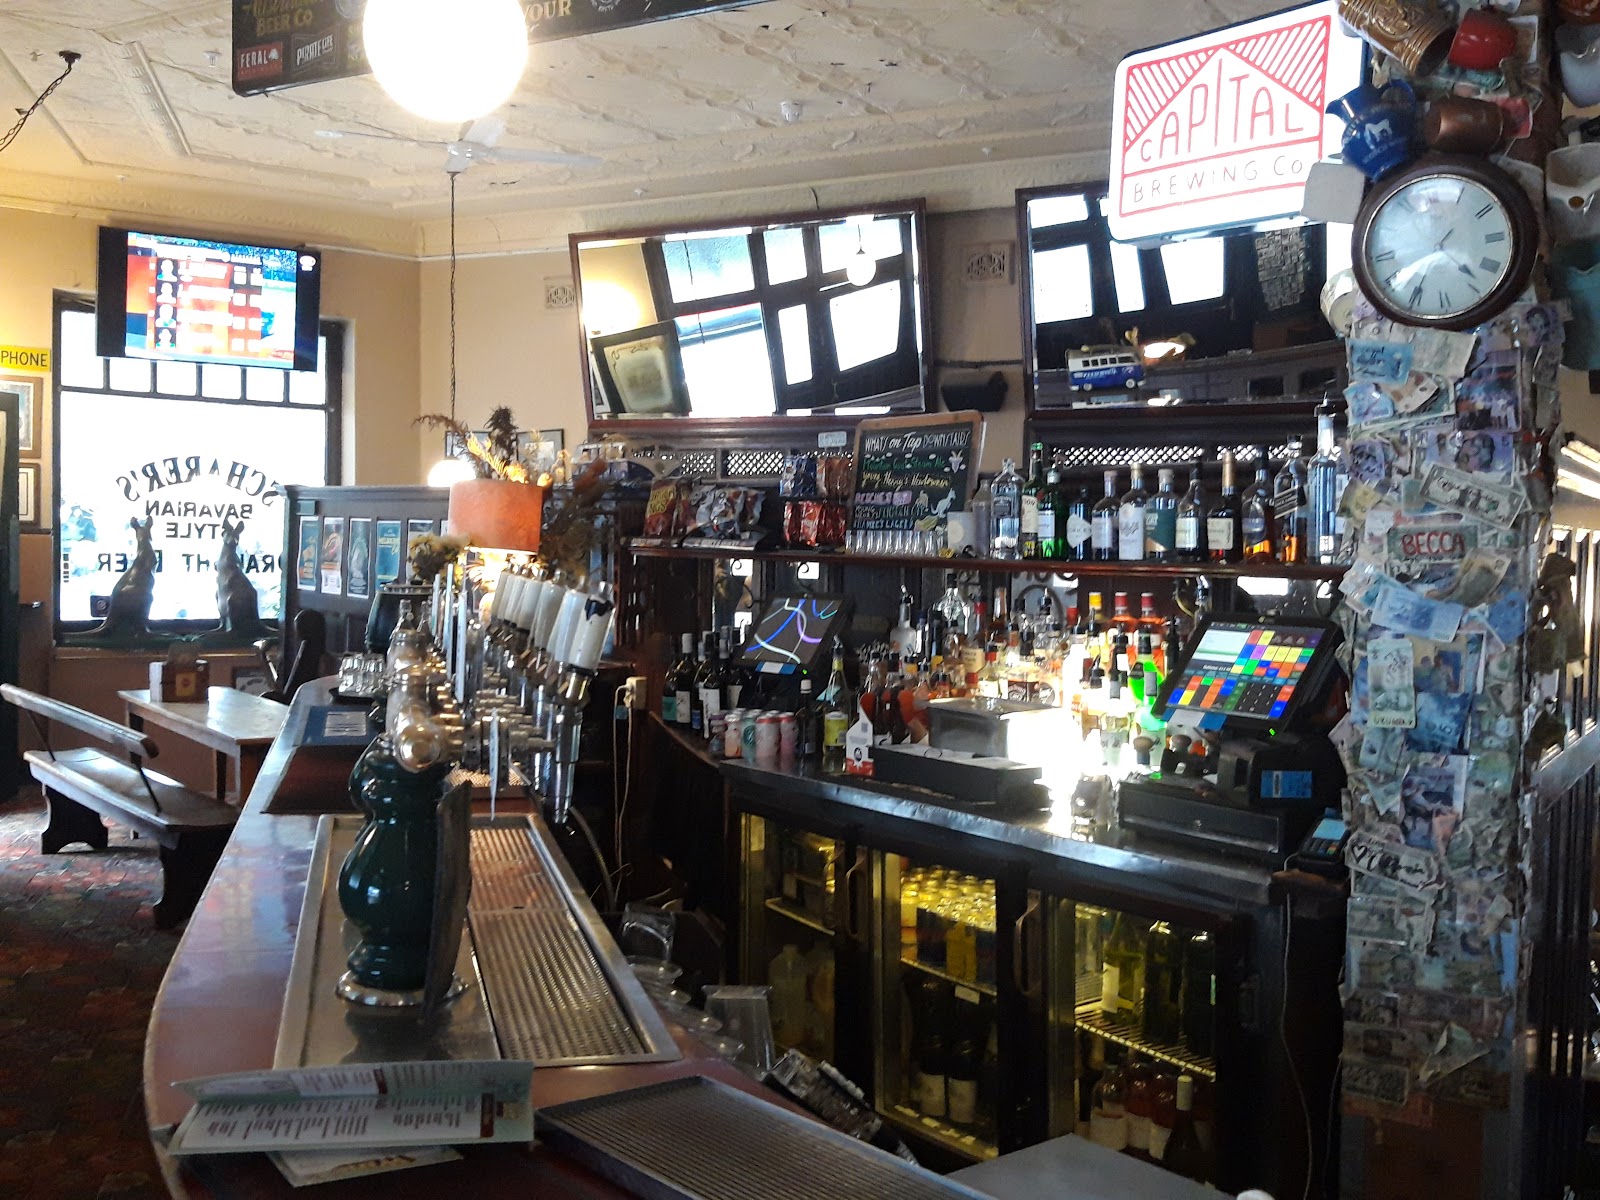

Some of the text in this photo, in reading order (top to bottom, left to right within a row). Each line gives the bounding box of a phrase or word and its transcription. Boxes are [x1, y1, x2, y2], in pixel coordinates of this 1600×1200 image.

[240, 49, 268, 69] FERAL
[296, 40, 322, 67] PIRATE
[1140, 58, 1304, 163] CAPITAL
[1, 350, 48, 368] PHONE
[902, 431, 923, 453] Tap
[1401, 530, 1468, 557] BECCA
